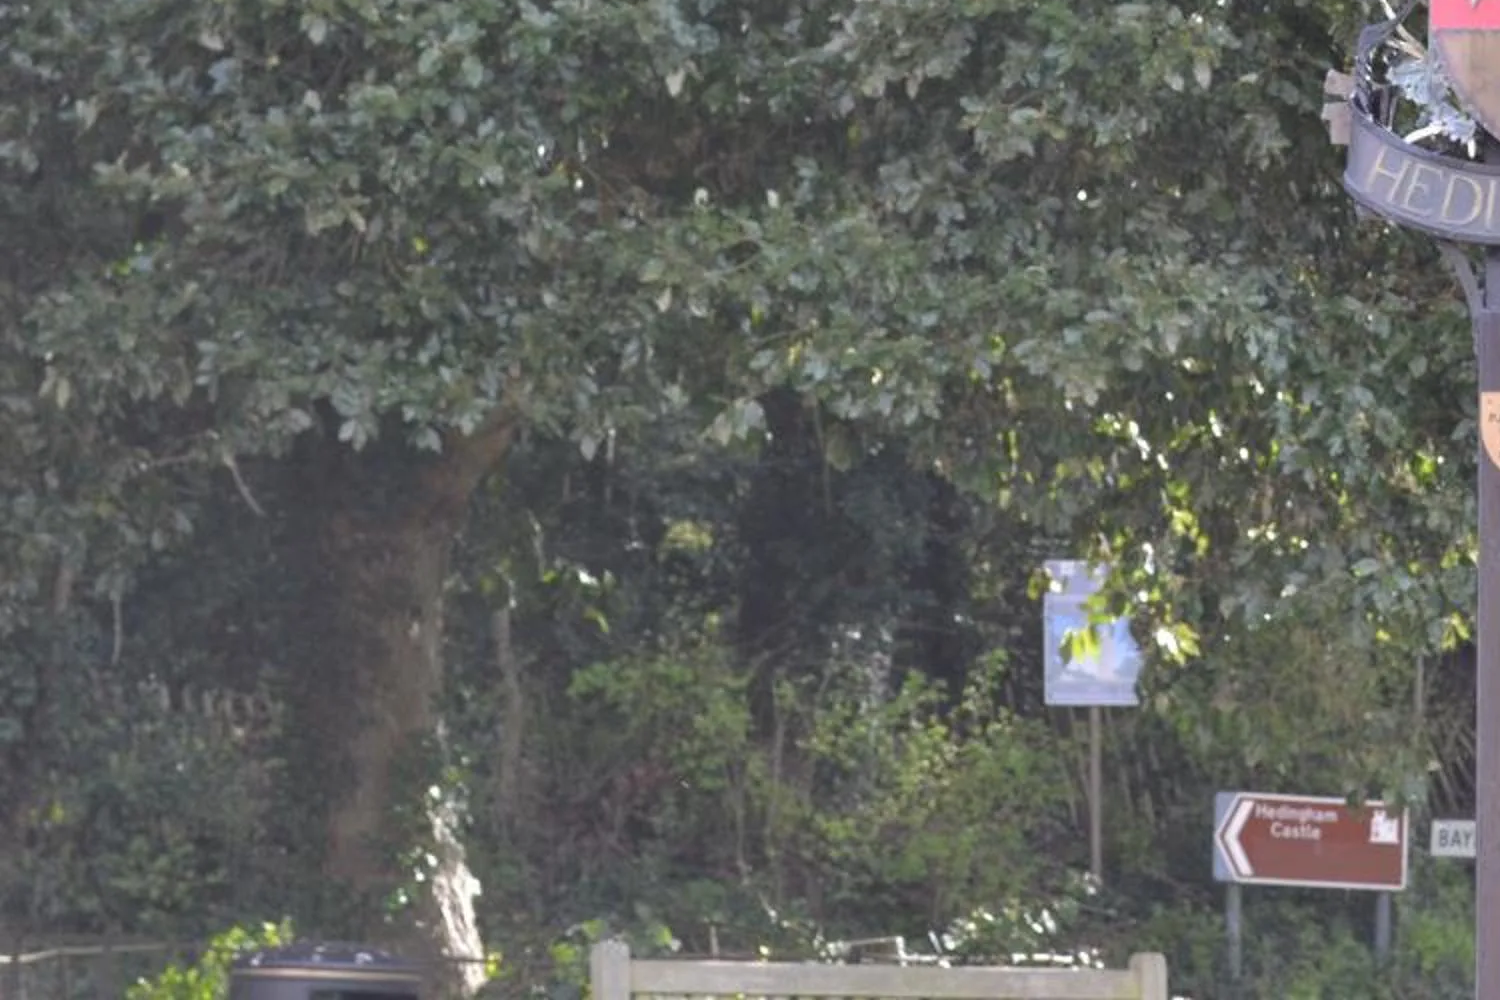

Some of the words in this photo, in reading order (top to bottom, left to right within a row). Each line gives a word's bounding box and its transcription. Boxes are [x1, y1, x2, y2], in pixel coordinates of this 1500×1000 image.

[1255, 803, 1338, 823] Hedingham
[1270, 822, 1322, 840] Castle
[1439, 829, 1476, 848] BAY
